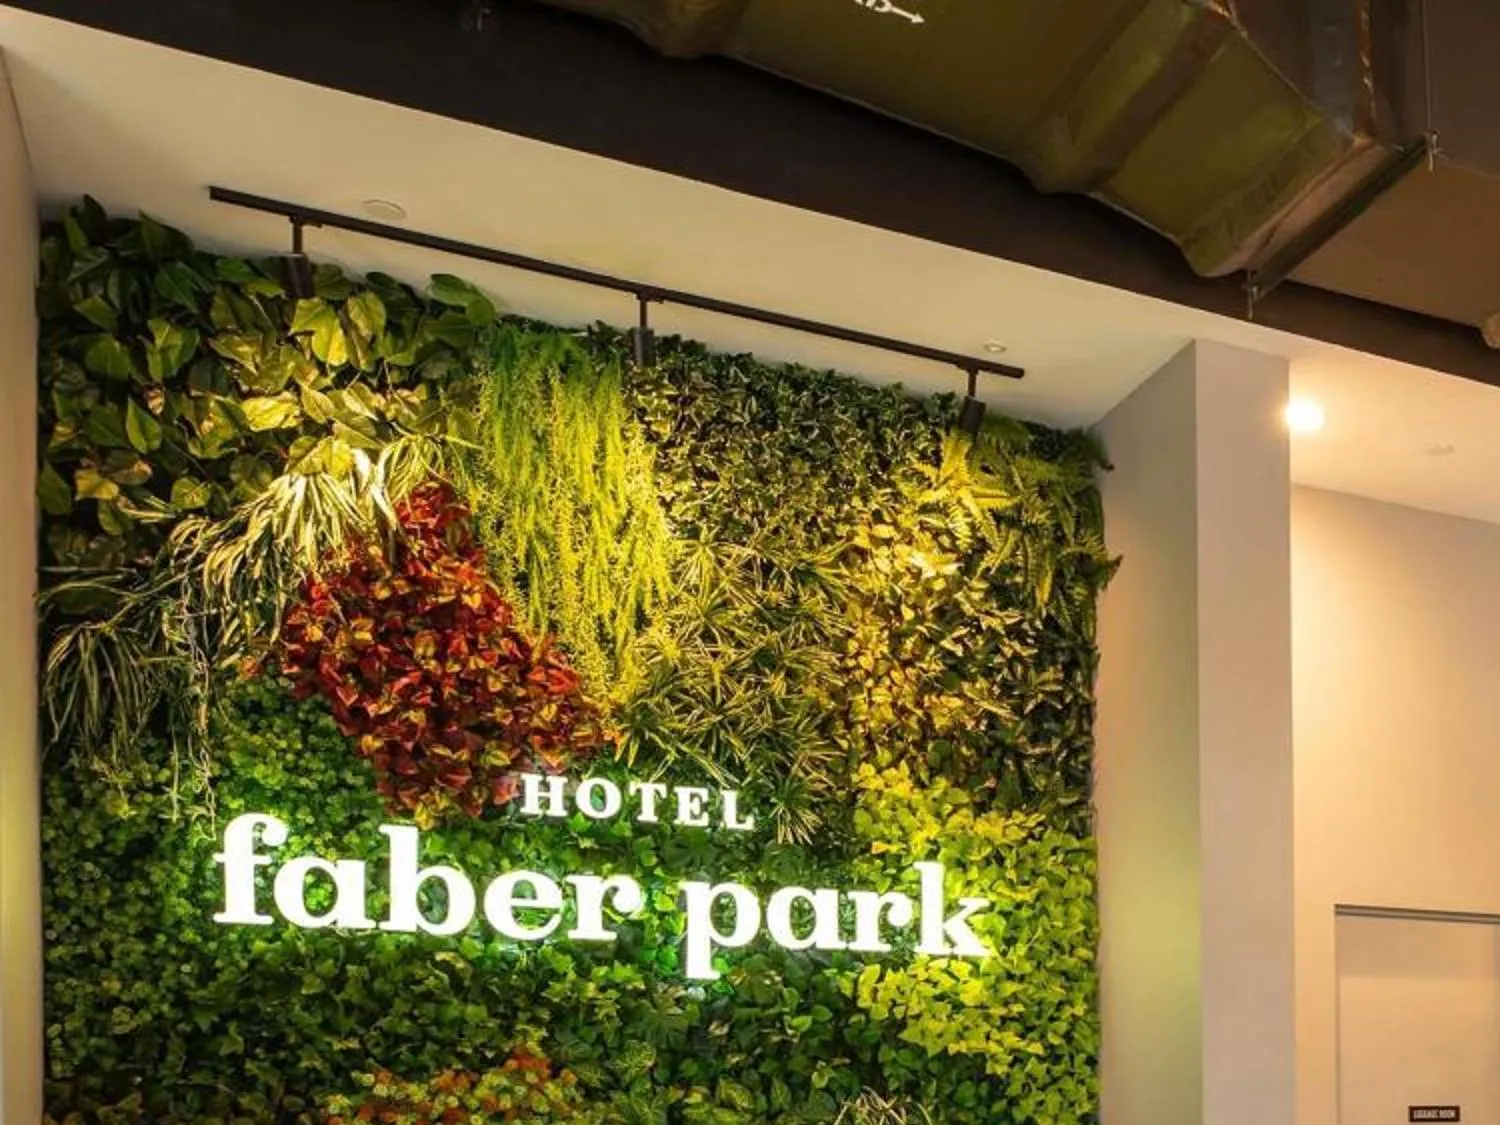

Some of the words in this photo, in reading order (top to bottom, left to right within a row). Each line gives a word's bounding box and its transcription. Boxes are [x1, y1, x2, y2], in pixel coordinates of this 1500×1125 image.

[520, 774, 755, 831] HOTEL
[212, 813, 645, 940] faber
[683, 861, 990, 979] park
